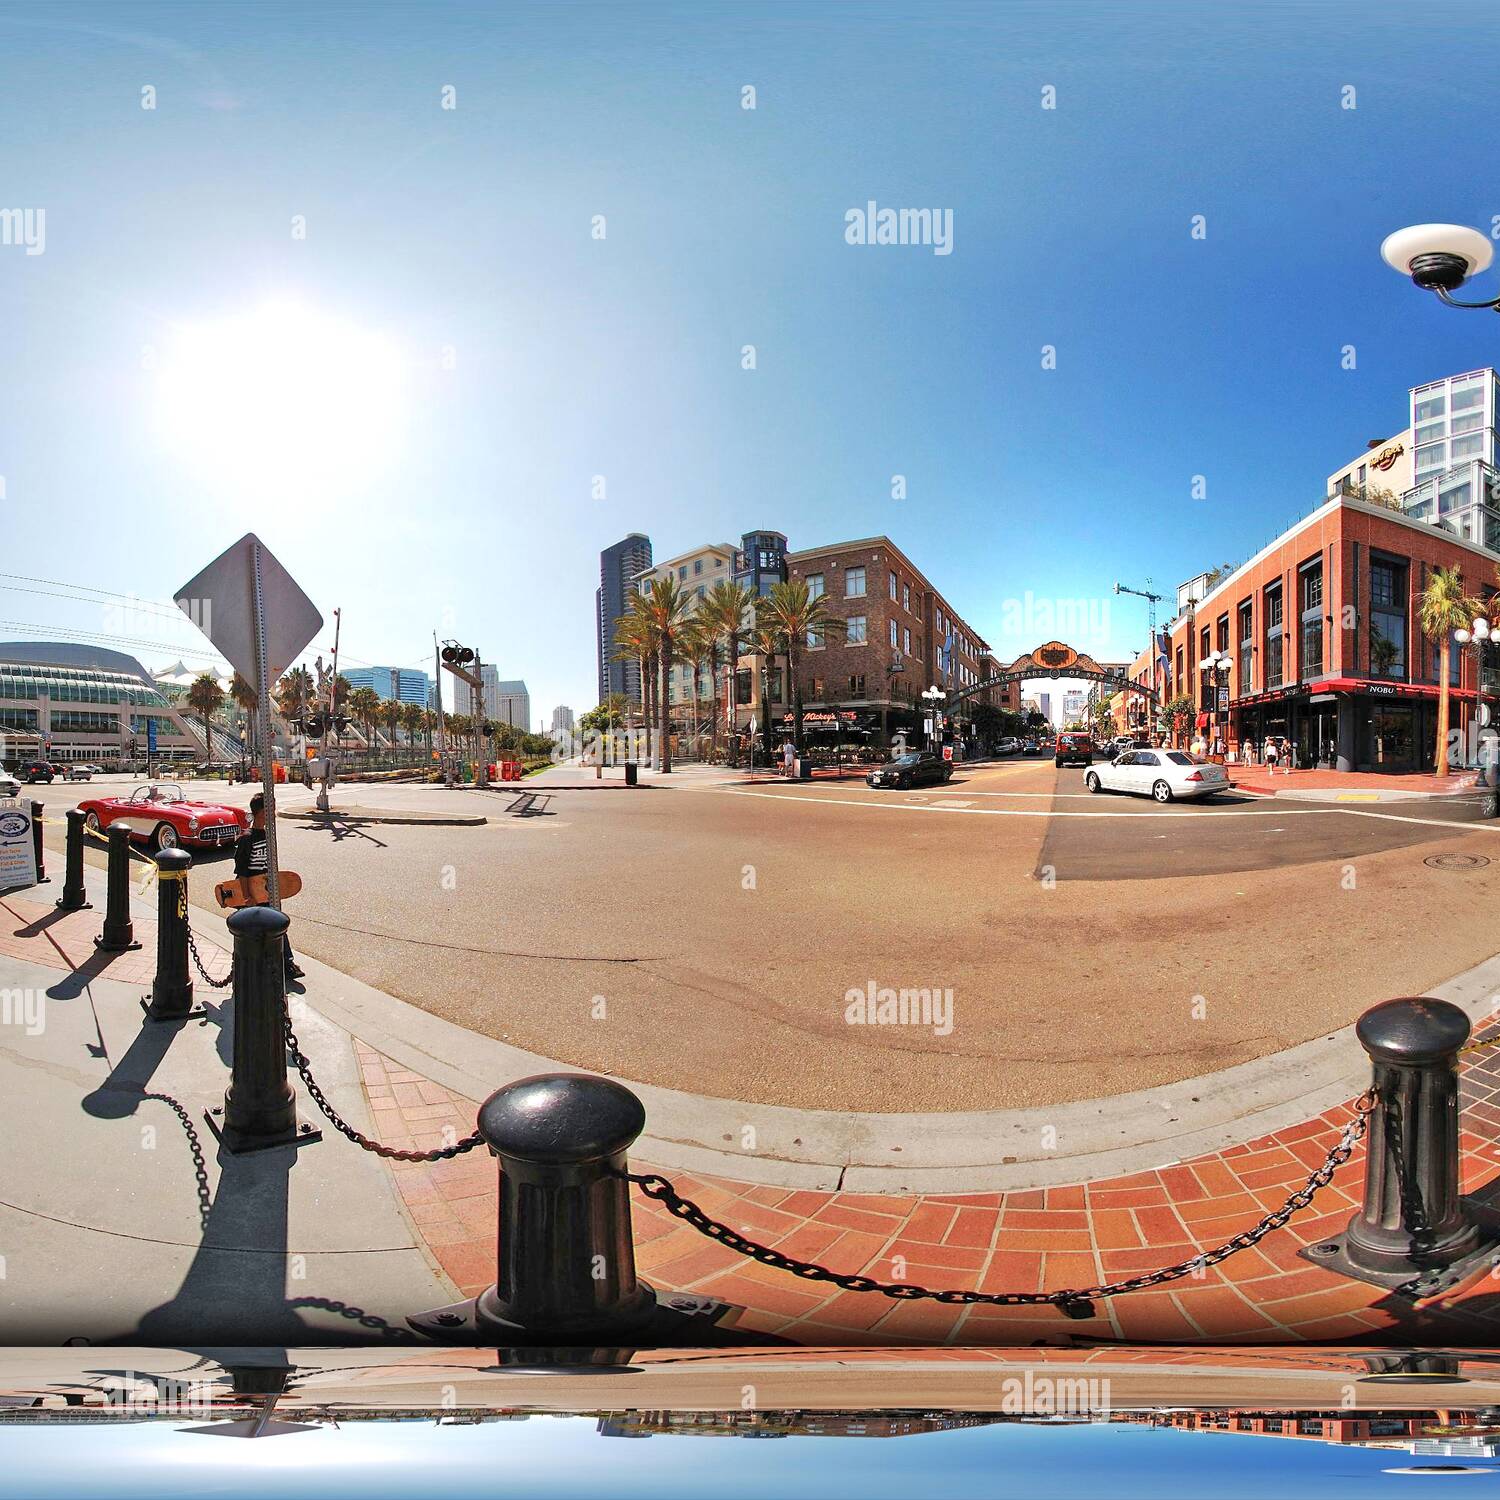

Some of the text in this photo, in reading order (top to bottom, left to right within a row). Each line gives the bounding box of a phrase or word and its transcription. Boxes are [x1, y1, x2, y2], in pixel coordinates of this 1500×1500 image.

[969, 675, 1010, 692] HISTORIC
[1015, 670, 1043, 679] HEART
[1085, 672, 1105, 680] SAN
[1110, 676, 1141, 691] DIEGO
[1369, 686, 1394, 694] NOBU
[784, 713, 795, 722] Lo
[803, 712, 836, 723] Mickey's
